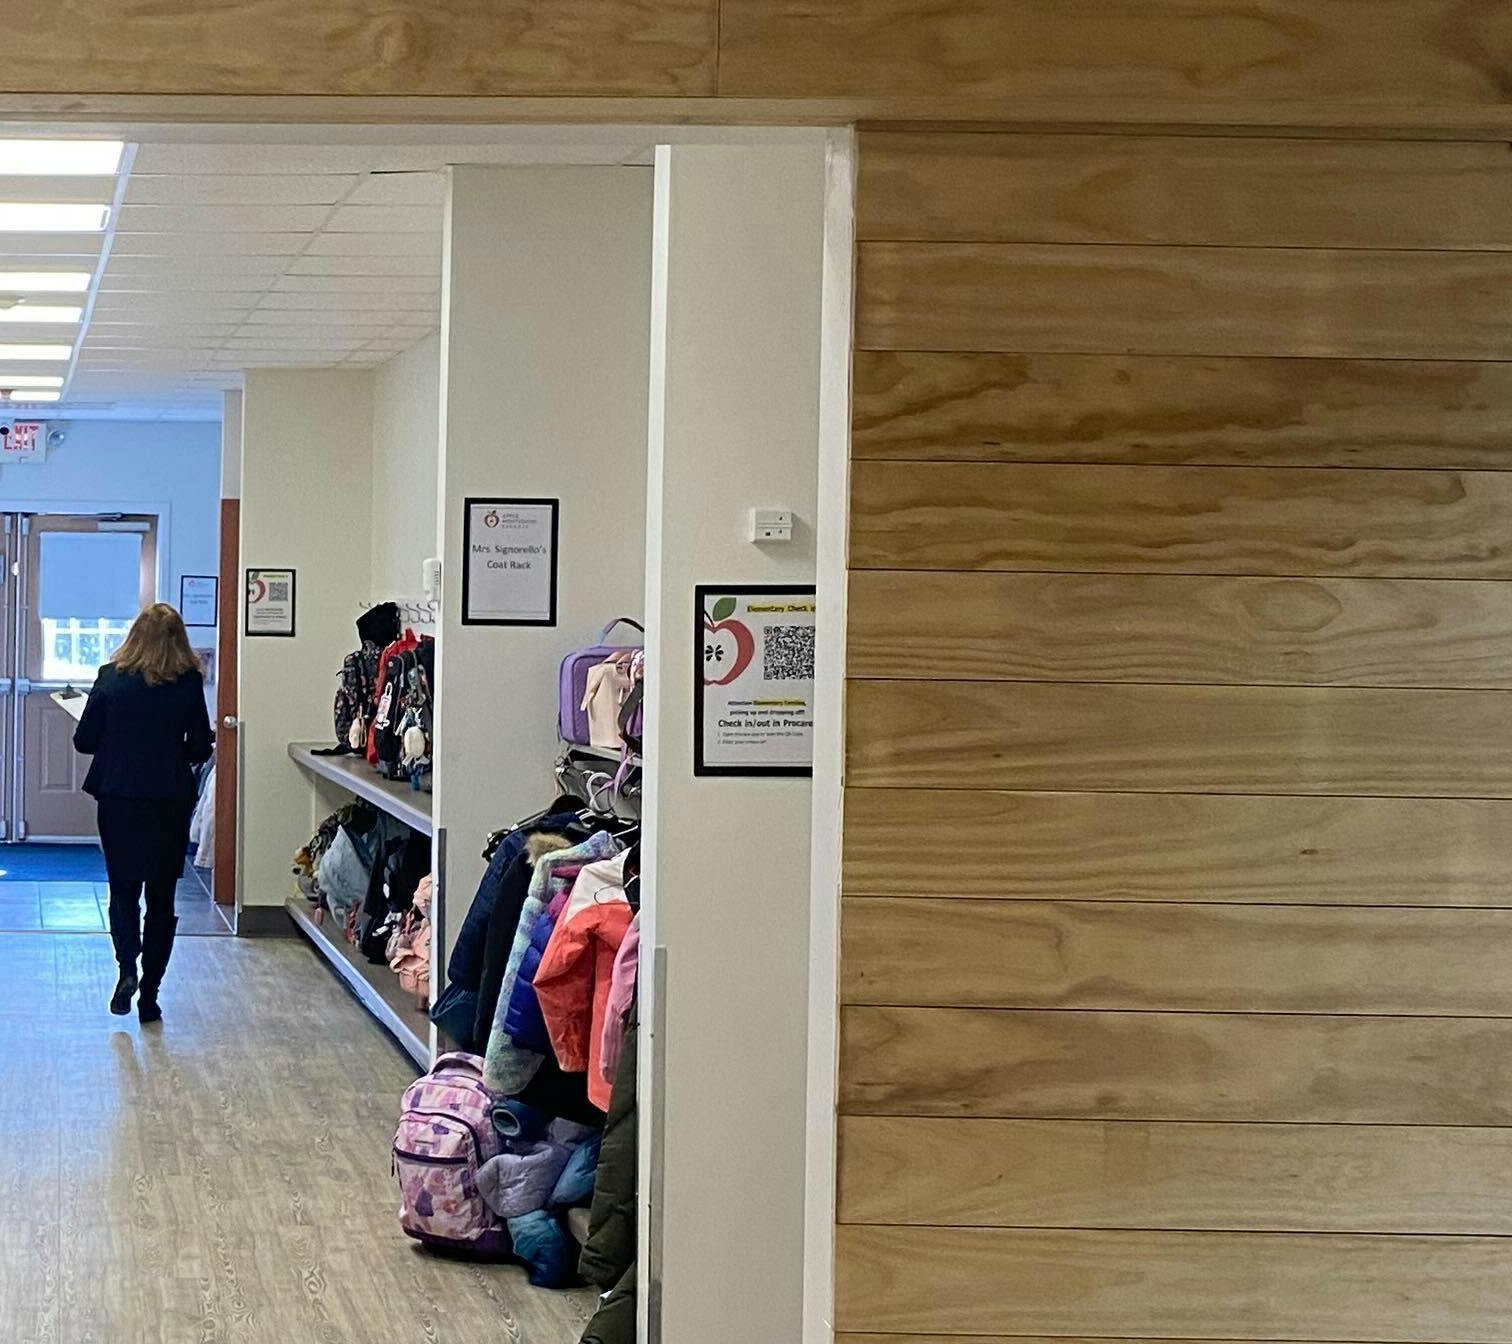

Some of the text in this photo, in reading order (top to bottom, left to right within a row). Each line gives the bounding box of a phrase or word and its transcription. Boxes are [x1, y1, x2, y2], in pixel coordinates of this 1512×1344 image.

[487, 560, 531, 569] Coat Rack
[718, 719, 742, 727] Check
[744, 719, 770, 728] in/out
